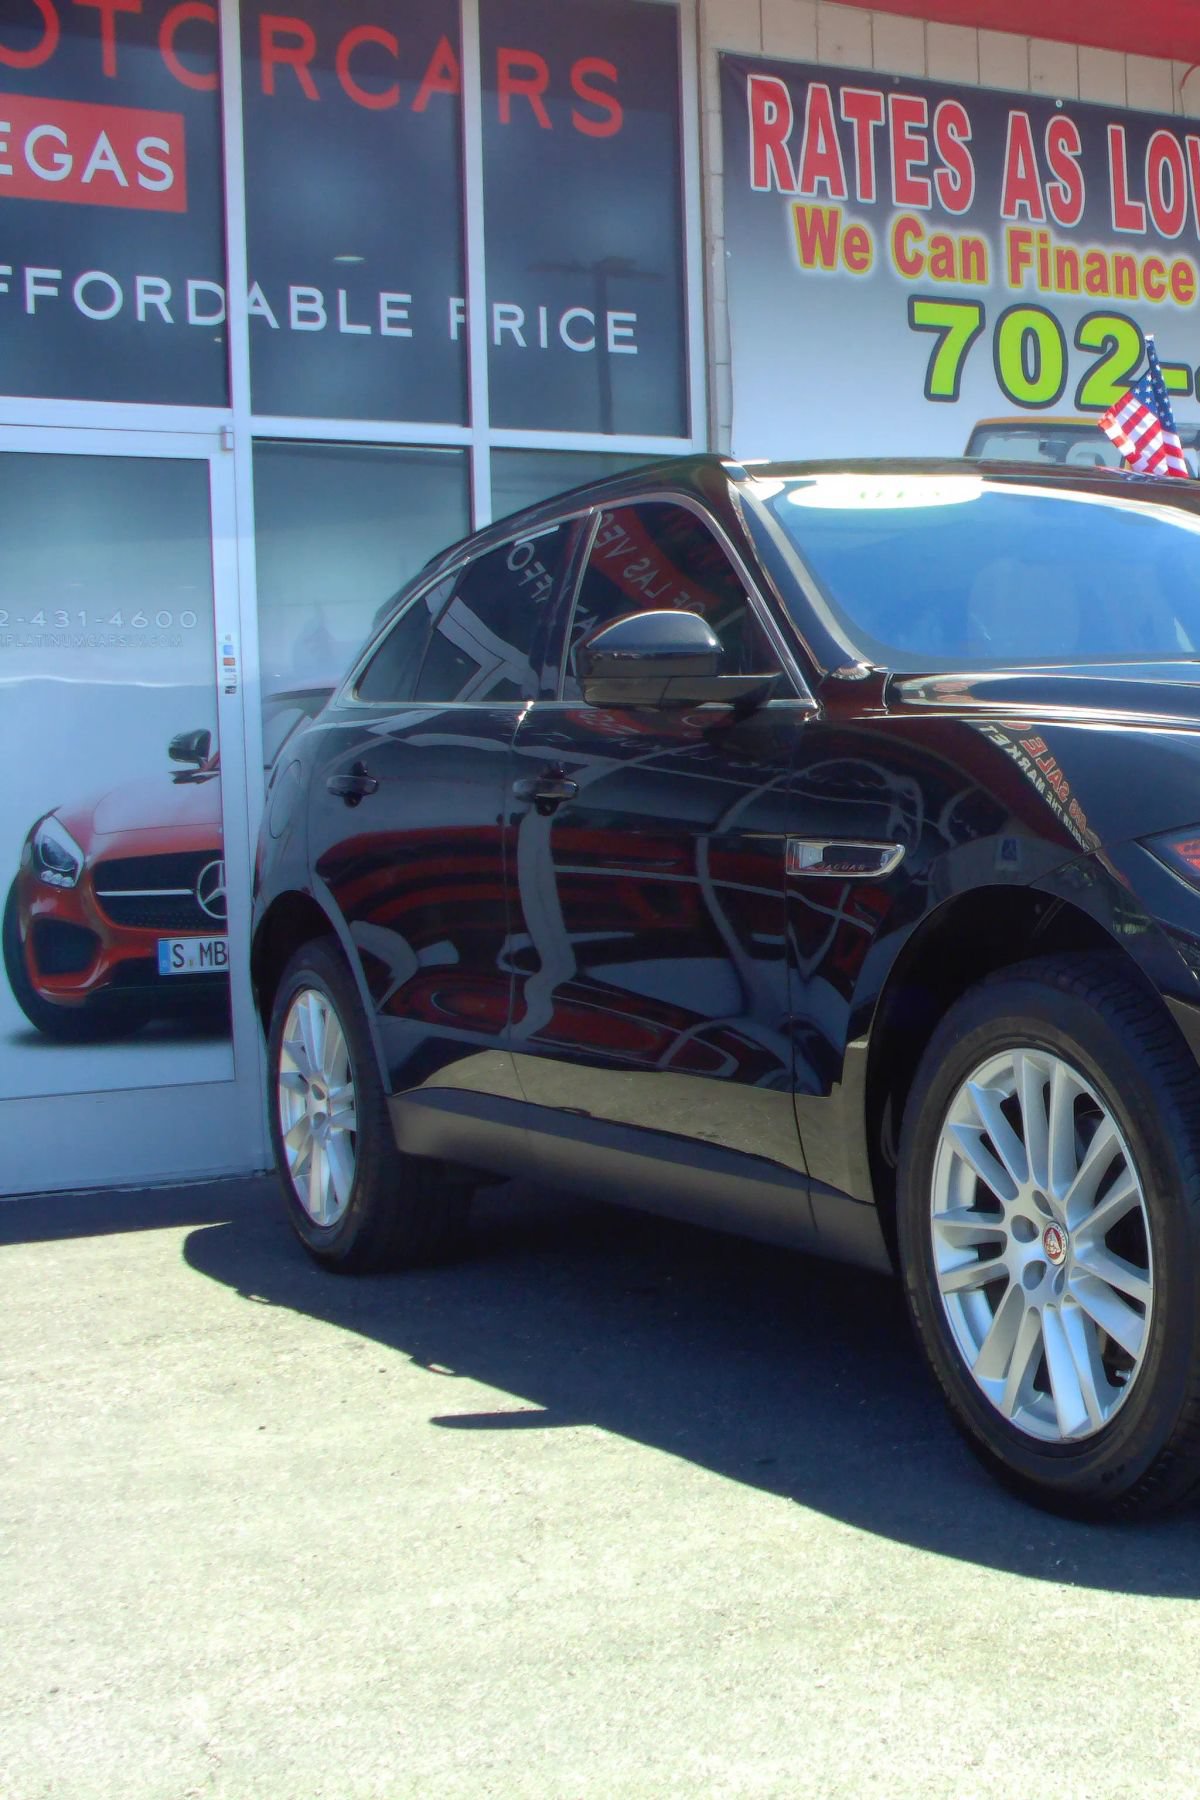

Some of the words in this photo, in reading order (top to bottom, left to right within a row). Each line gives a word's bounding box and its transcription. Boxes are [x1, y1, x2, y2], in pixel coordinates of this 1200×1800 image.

[747, 74, 975, 215] RATES
[1000, 110, 1086, 228] AS
[792, 203, 873, 273] We
[892, 214, 988, 285] Can
[1008, 226, 1196, 304] Finance
